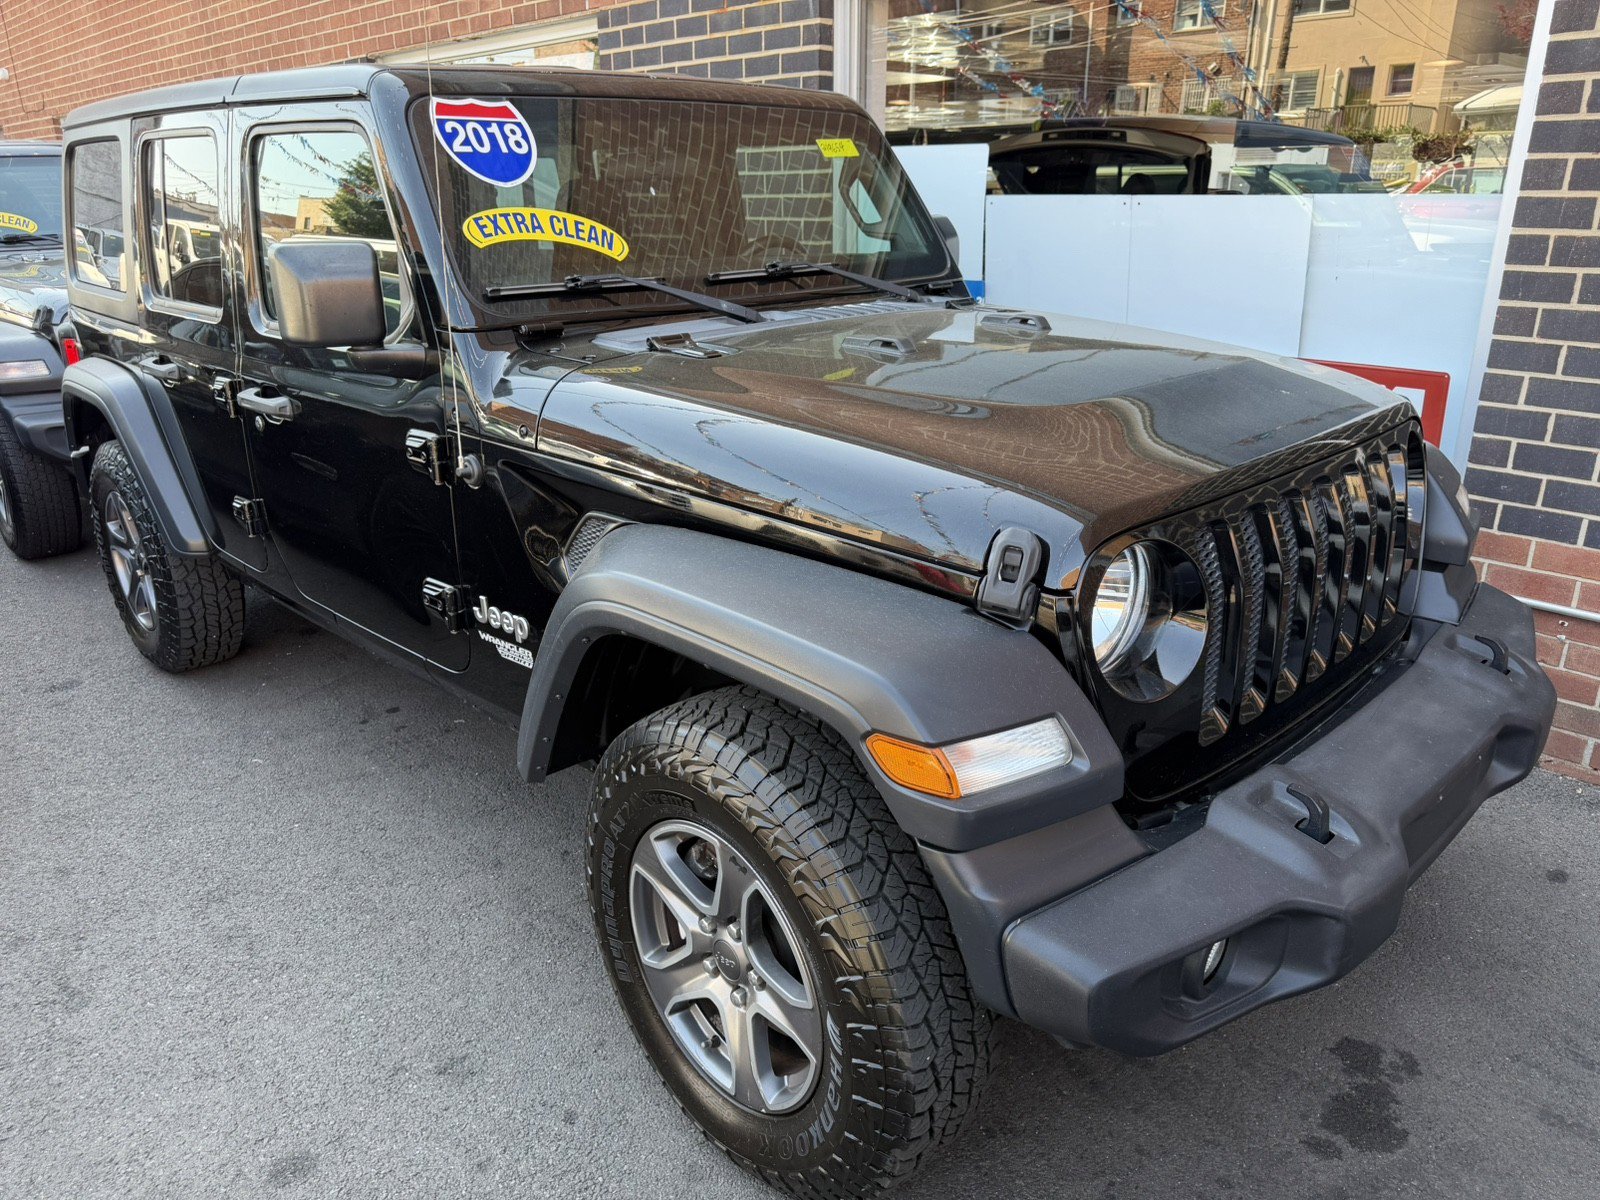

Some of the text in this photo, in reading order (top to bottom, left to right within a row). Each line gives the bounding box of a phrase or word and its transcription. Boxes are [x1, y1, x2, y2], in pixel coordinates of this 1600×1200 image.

[445, 121, 529, 155] 2018
[473, 212, 615, 251] EXTRA CLEAN
[472, 595, 529, 643] Jeep
[478, 629, 533, 657] WRANGLER
